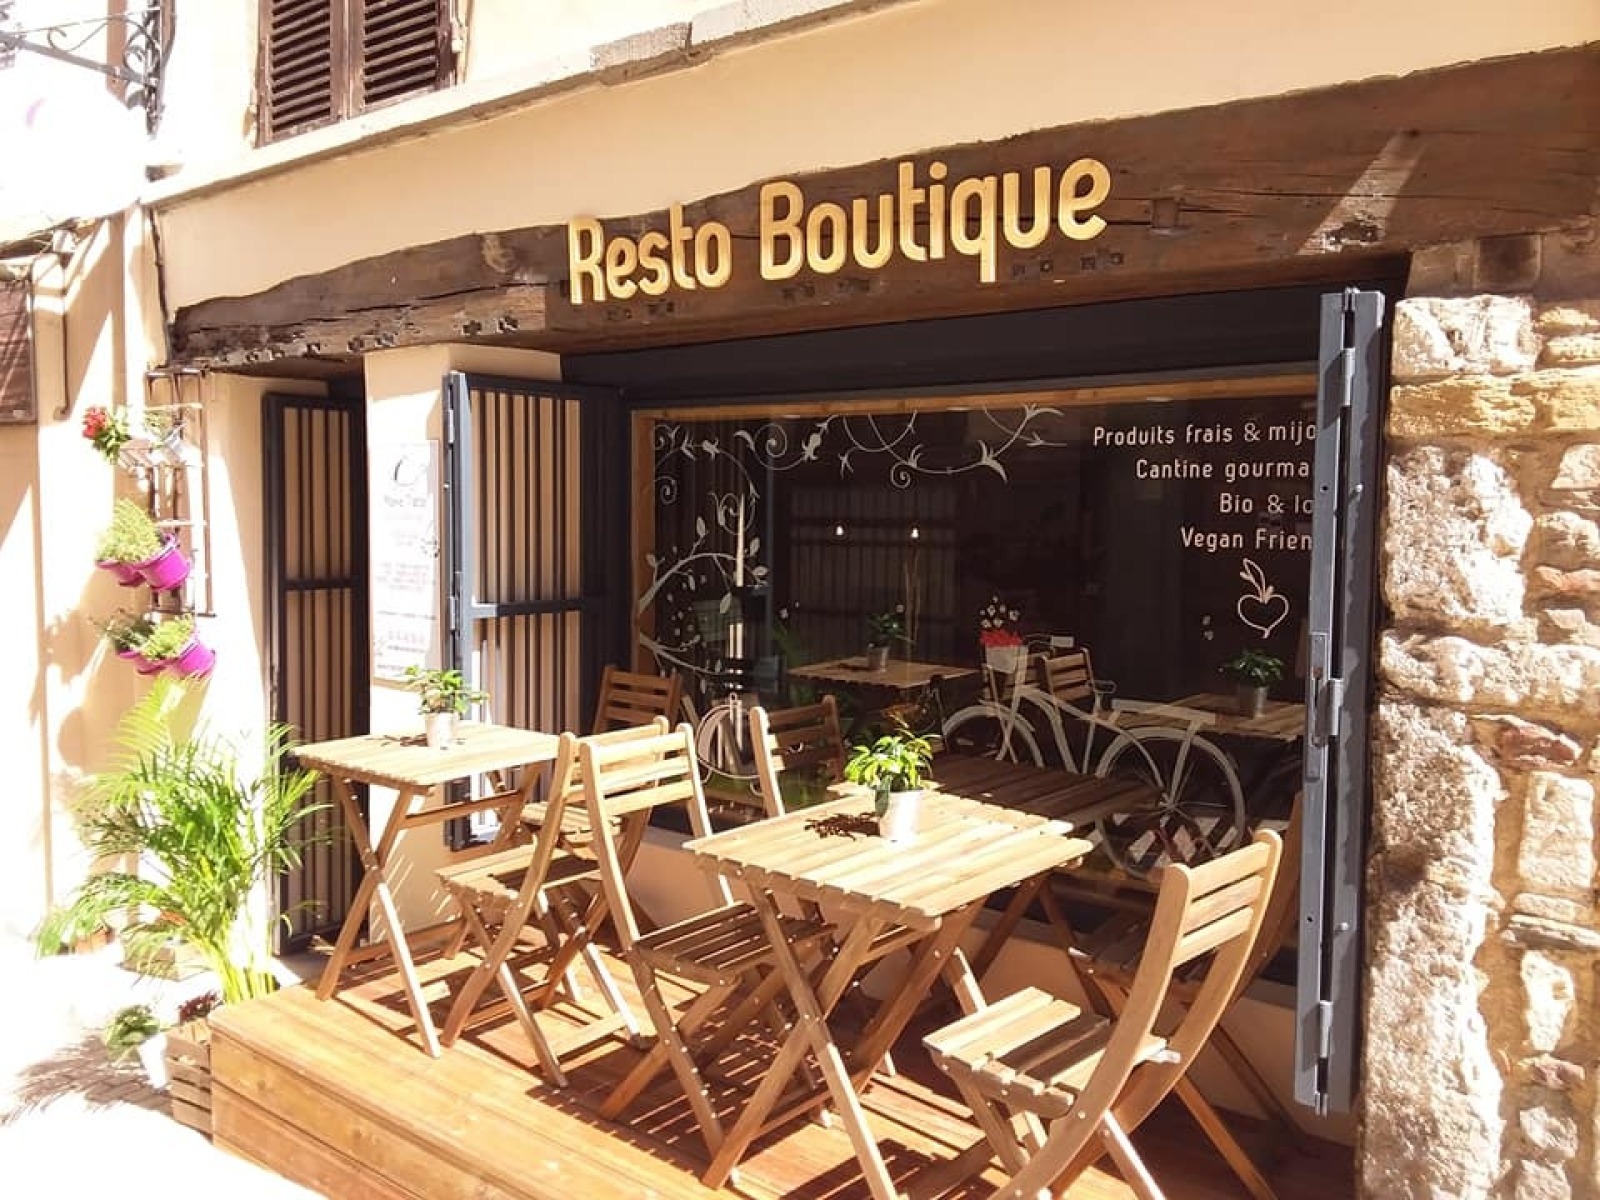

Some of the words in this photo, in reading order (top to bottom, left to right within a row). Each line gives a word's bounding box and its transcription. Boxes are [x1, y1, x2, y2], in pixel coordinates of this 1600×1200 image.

[567, 202, 733, 305] Resto
[759, 157, 1112, 283] Boutique
[1093, 426, 1176, 446] Produits
[1186, 423, 1233, 443] frais
[1244, 422, 1261, 442] &
[1135, 458, 1213, 479] Cantine
[1224, 460, 1310, 483] gourma
[1219, 492, 1253, 514] Bio
[1267, 494, 1285, 514] &
[1180, 526, 1243, 552] Vegan
[1255, 527, 1313, 550] Frien
